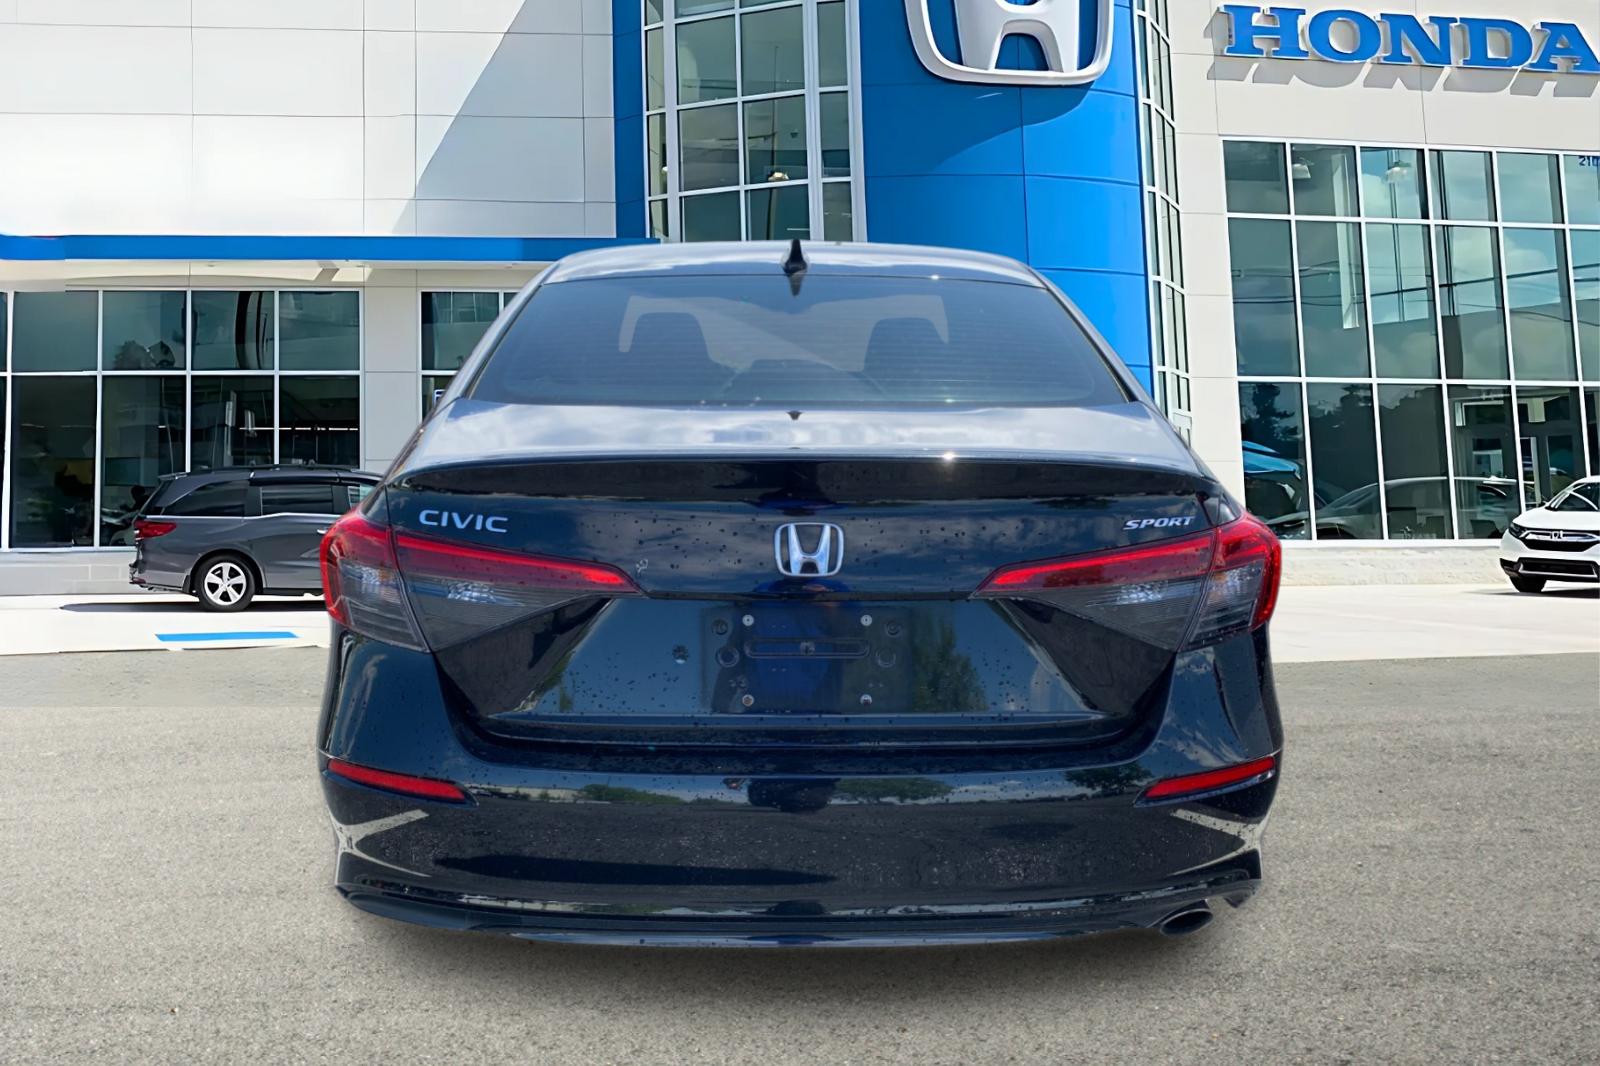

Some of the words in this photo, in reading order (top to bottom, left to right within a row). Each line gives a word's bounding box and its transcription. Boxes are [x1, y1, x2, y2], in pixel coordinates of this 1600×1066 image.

[1223, 4, 1600, 73] HONDA
[419, 510, 508, 533] CIVIC
[1123, 516, 1195, 530] SPORT
